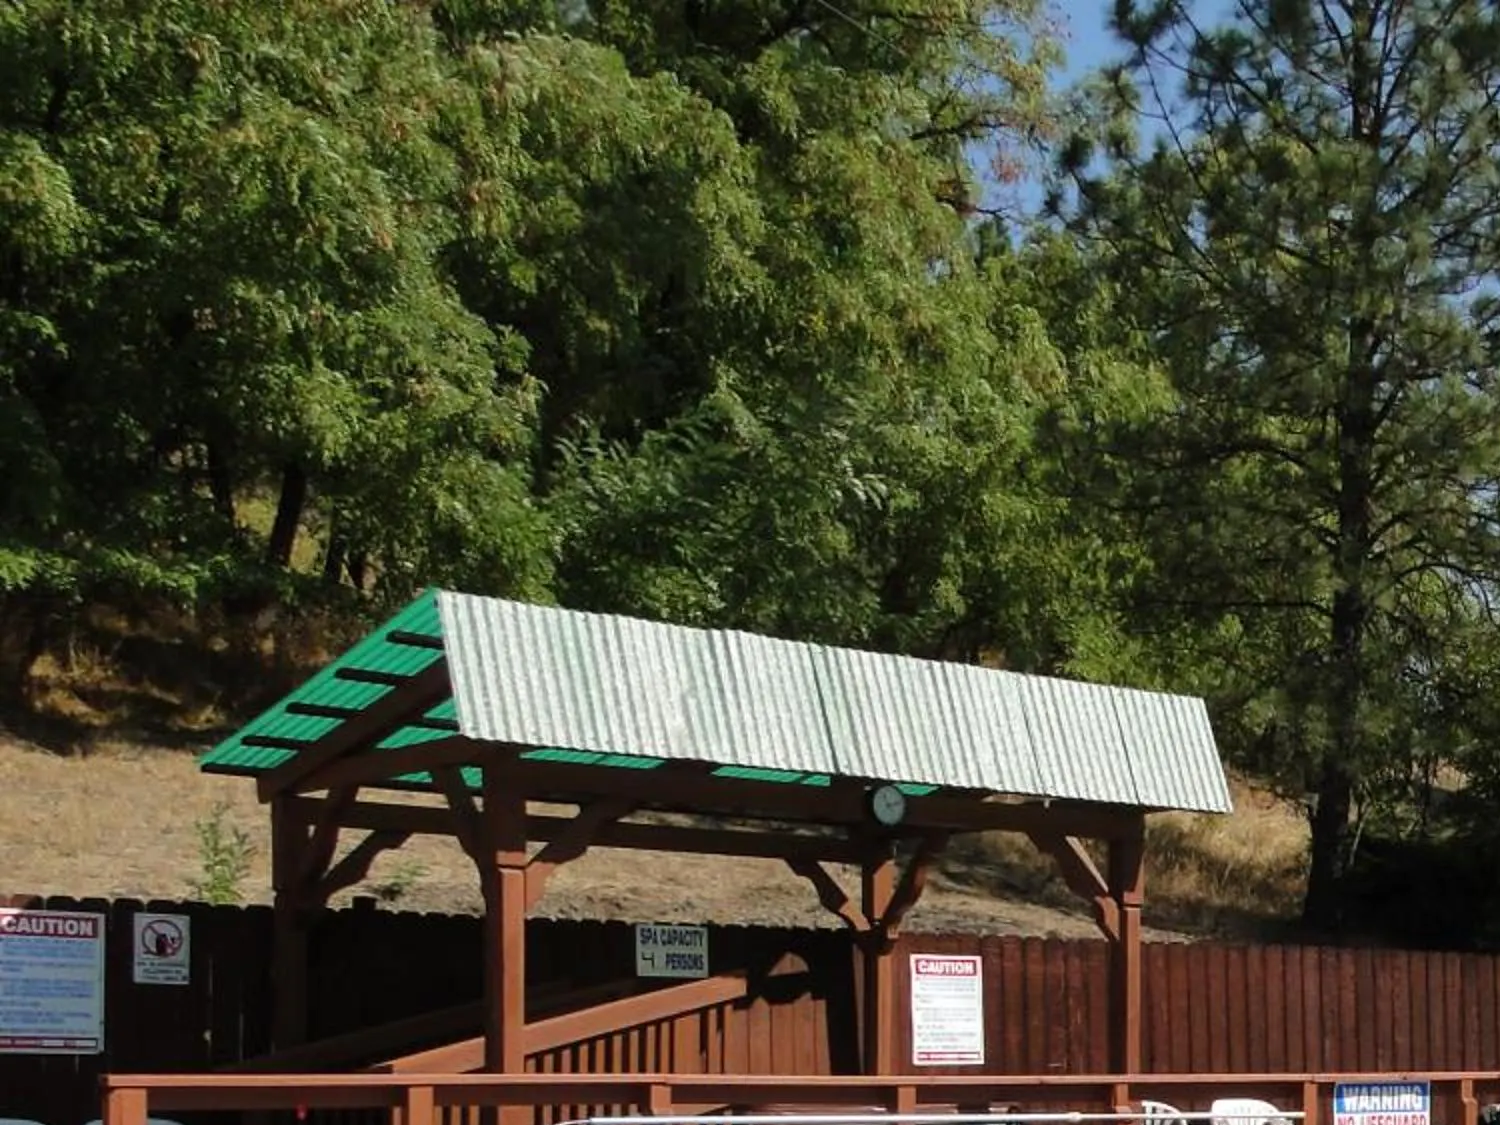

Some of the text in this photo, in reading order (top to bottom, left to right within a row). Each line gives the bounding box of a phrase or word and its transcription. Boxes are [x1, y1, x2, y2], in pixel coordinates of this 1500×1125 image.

[3, 917, 94, 936] CAUTION
[640, 927, 704, 947] SPA CAPACITY
[641, 951, 704, 970] 4 PERSONS
[917, 960, 974, 975] CAUTION
[1343, 1085, 1423, 1112] WARNING
